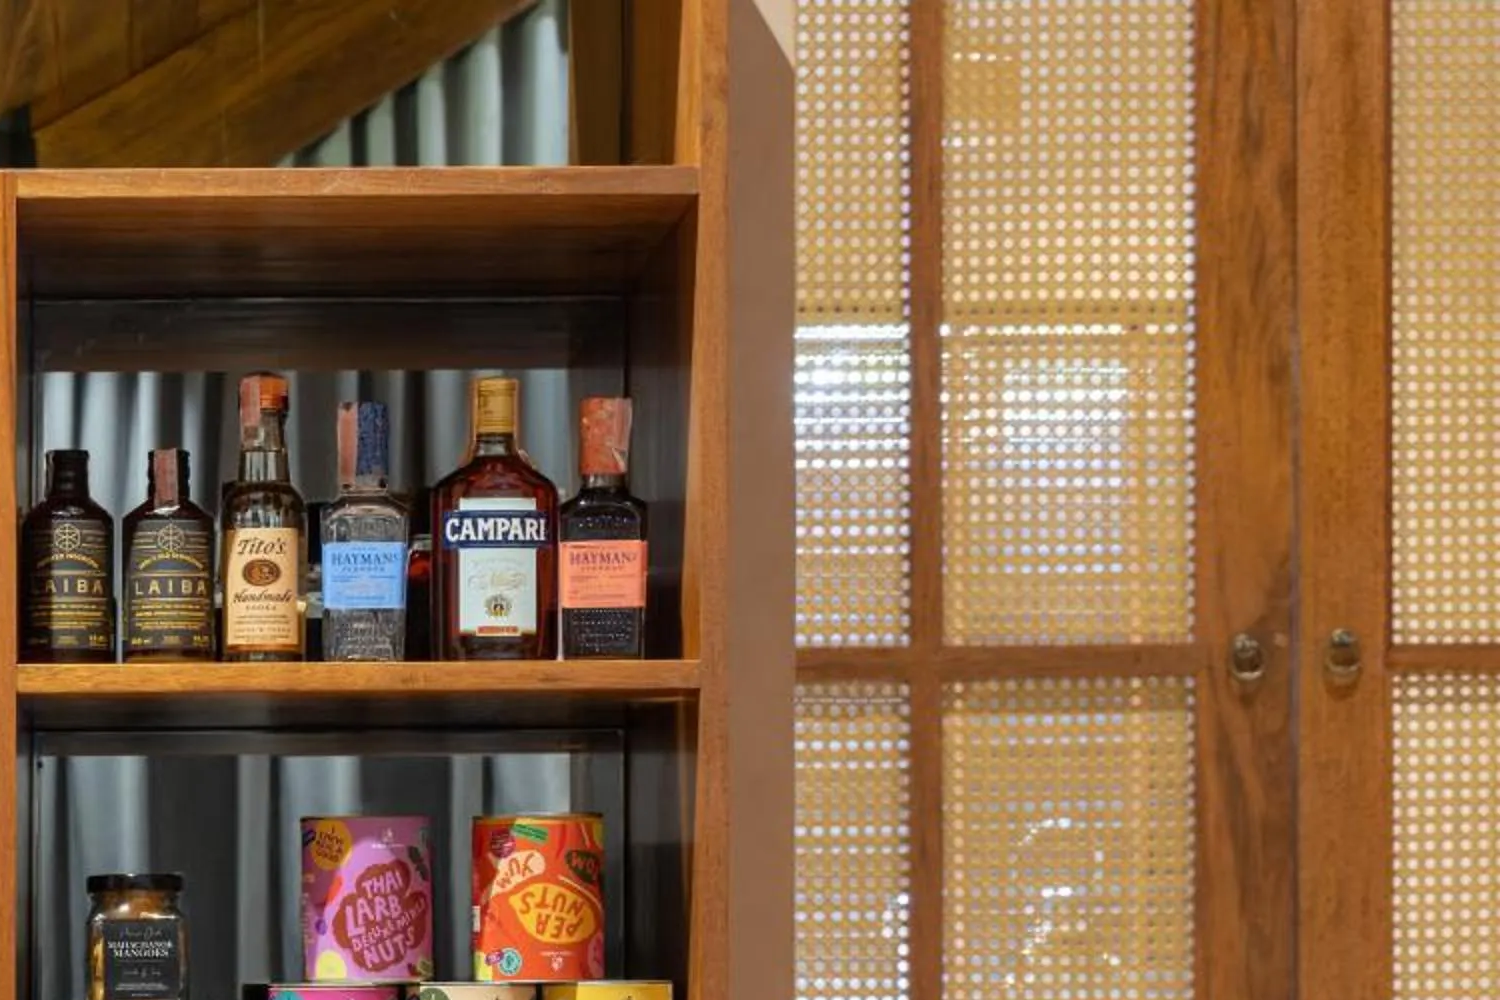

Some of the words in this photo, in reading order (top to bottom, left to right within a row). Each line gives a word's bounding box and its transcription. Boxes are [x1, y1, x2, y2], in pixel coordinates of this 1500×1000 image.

[445, 517, 546, 542] CAMPARI
[237, 537, 287, 555] Tito's
[33, 578, 103, 594] AIBA
[134, 579, 207, 596] LAIBA
[361, 870, 404, 899] THAI
[518, 886, 586, 917] NUTS
[344, 895, 401, 937] LARB
[535, 912, 584, 938] PEA
[363, 925, 416, 969] NUTS
